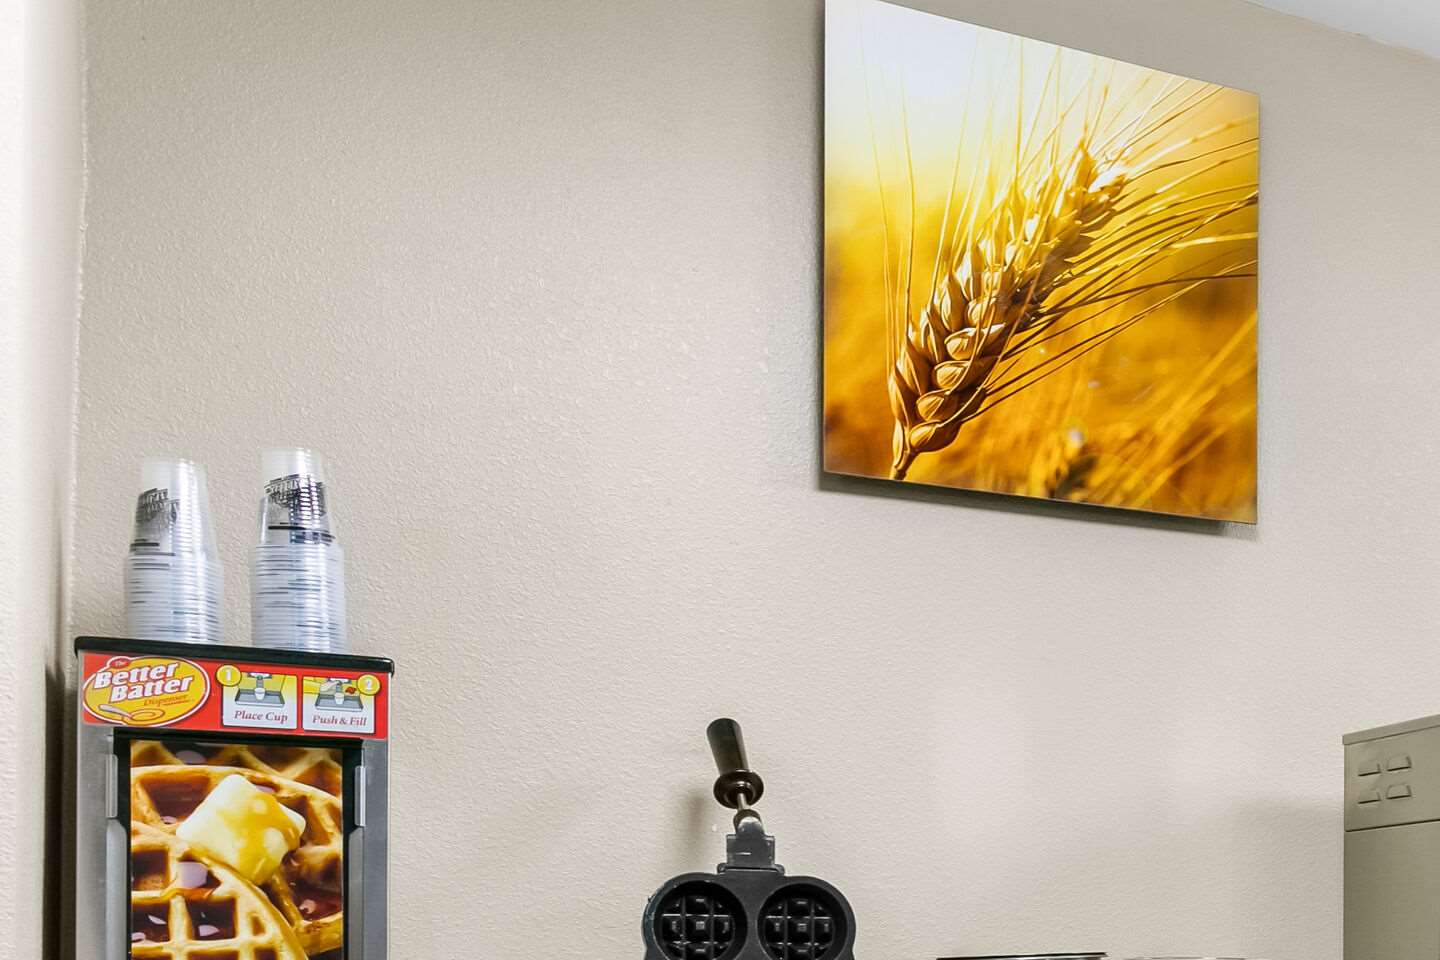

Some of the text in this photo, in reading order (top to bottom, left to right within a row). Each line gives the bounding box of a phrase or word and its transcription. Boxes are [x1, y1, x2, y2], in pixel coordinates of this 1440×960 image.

[93, 662, 179, 689] Better
[225, 668, 232, 680] 1
[110, 676, 193, 702] Batter
[365, 680, 372, 690] 2
[234, 710, 288, 725] Place Cup
[312, 714, 338, 724] Push
[350, 716, 367, 726] Fill
